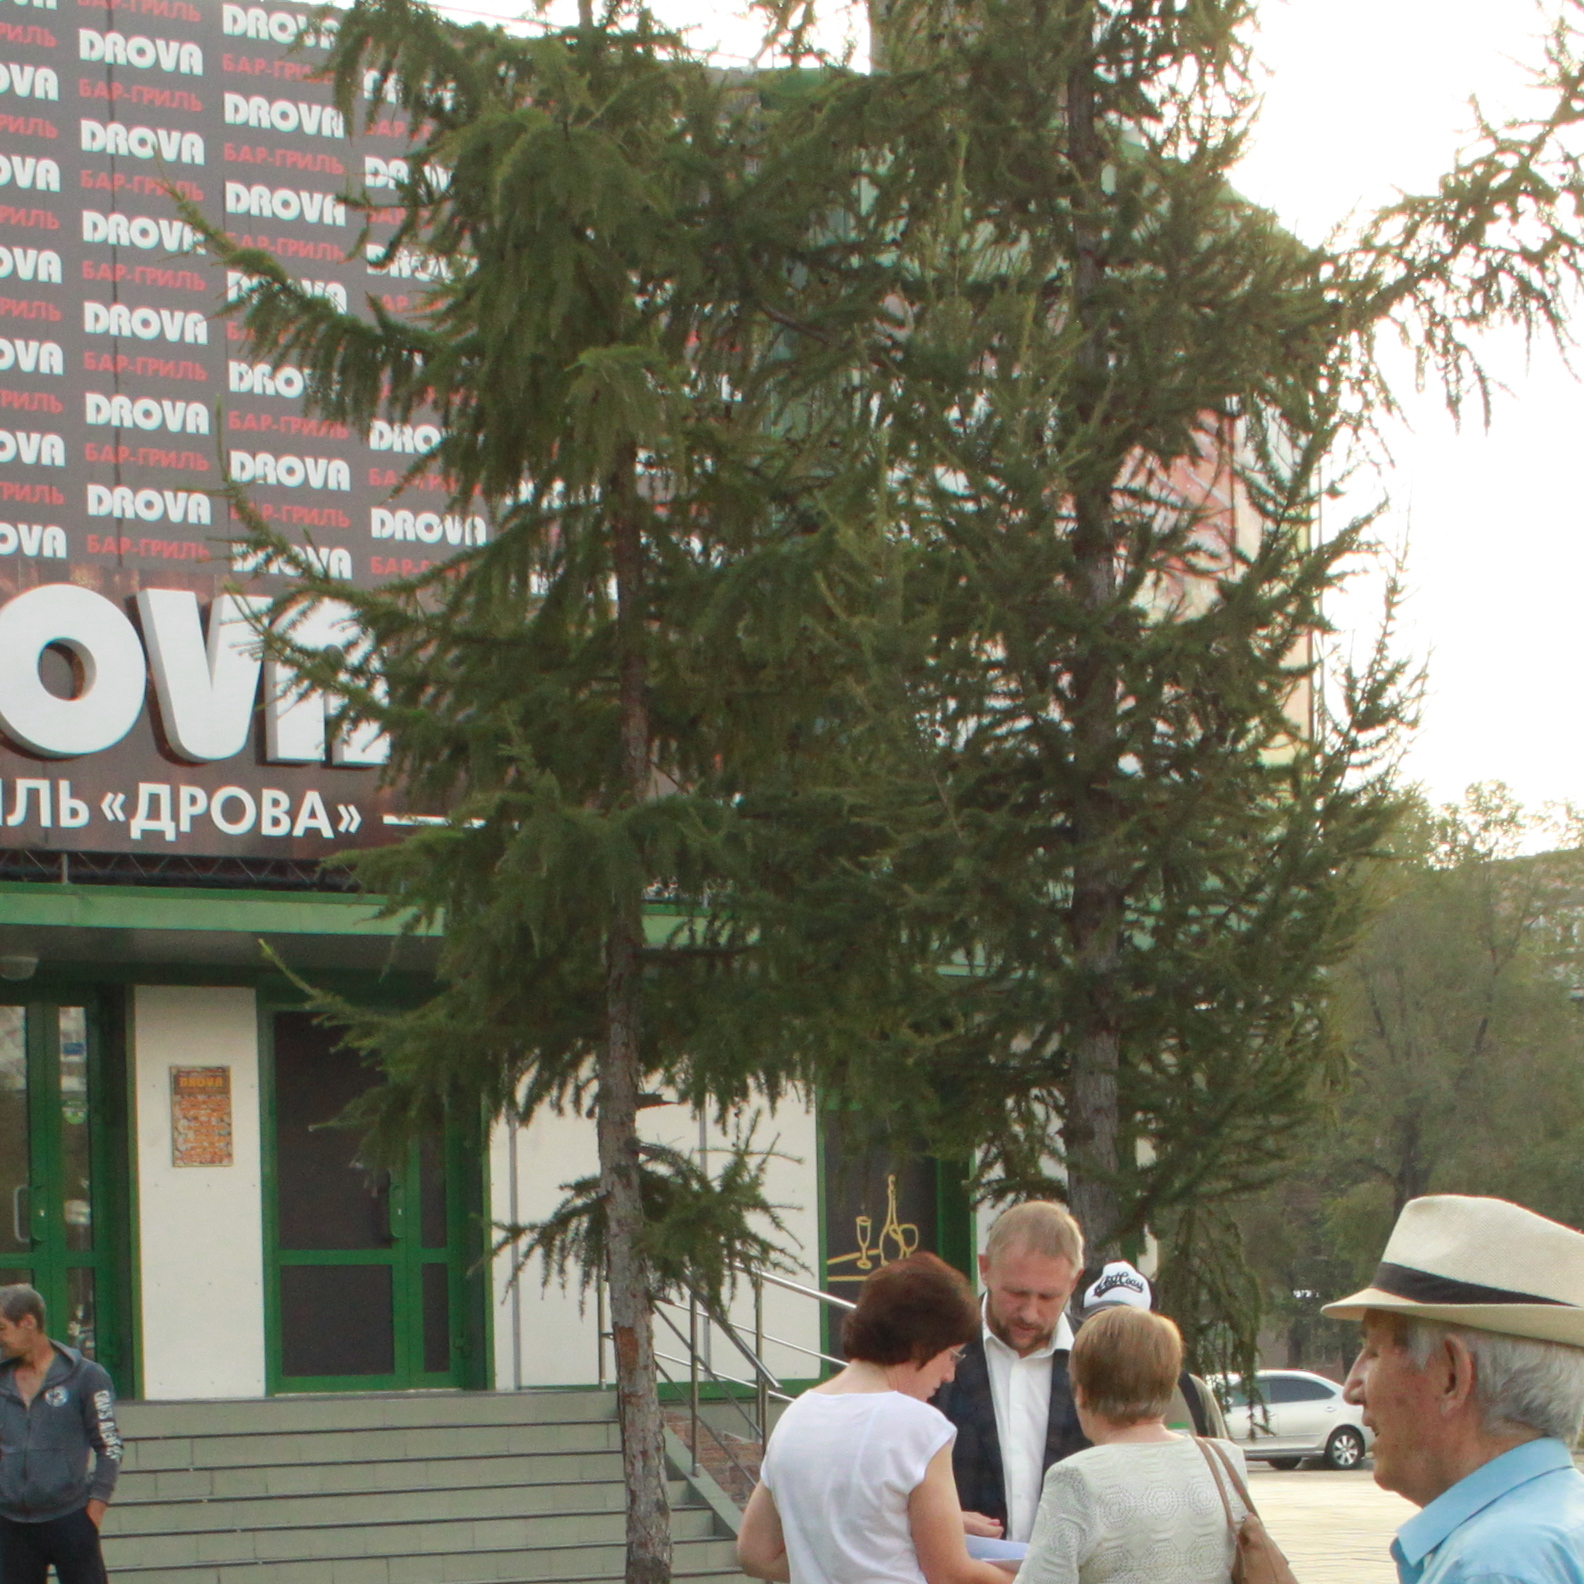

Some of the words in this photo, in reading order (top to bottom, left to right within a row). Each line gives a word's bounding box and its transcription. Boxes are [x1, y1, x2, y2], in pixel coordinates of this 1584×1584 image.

[78, 28, 203, 76] DROVA
[80, 79, 203, 111] БАР-ГРИЛЬ
[223, 92, 344, 139] DROVA
[80, 118, 204, 165] DROVA
[224, 143, 345, 174] БАР-ГРИЛЬ
[225, 181, 345, 226] DROVA
[82, 210, 206, 255] DROVA
[82, 261, 207, 291] БАР-ГРИЛЬ
[83, 301, 207, 345] DROVA
[84, 351, 208, 381] БАР-ГРИЛЬ
[85, 392, 209, 434] DROVA
[85, 443, 210, 471] БАР-ГРИЛЬ
[230, 450, 350, 491] DROVA
[86, 484, 211, 525] DROVA
[371, 507, 487, 546] DROVA
[87, 535, 211, 561] БАР-ГРИЛЬ
[101, 782, 361, 842] «ДРОВА»
